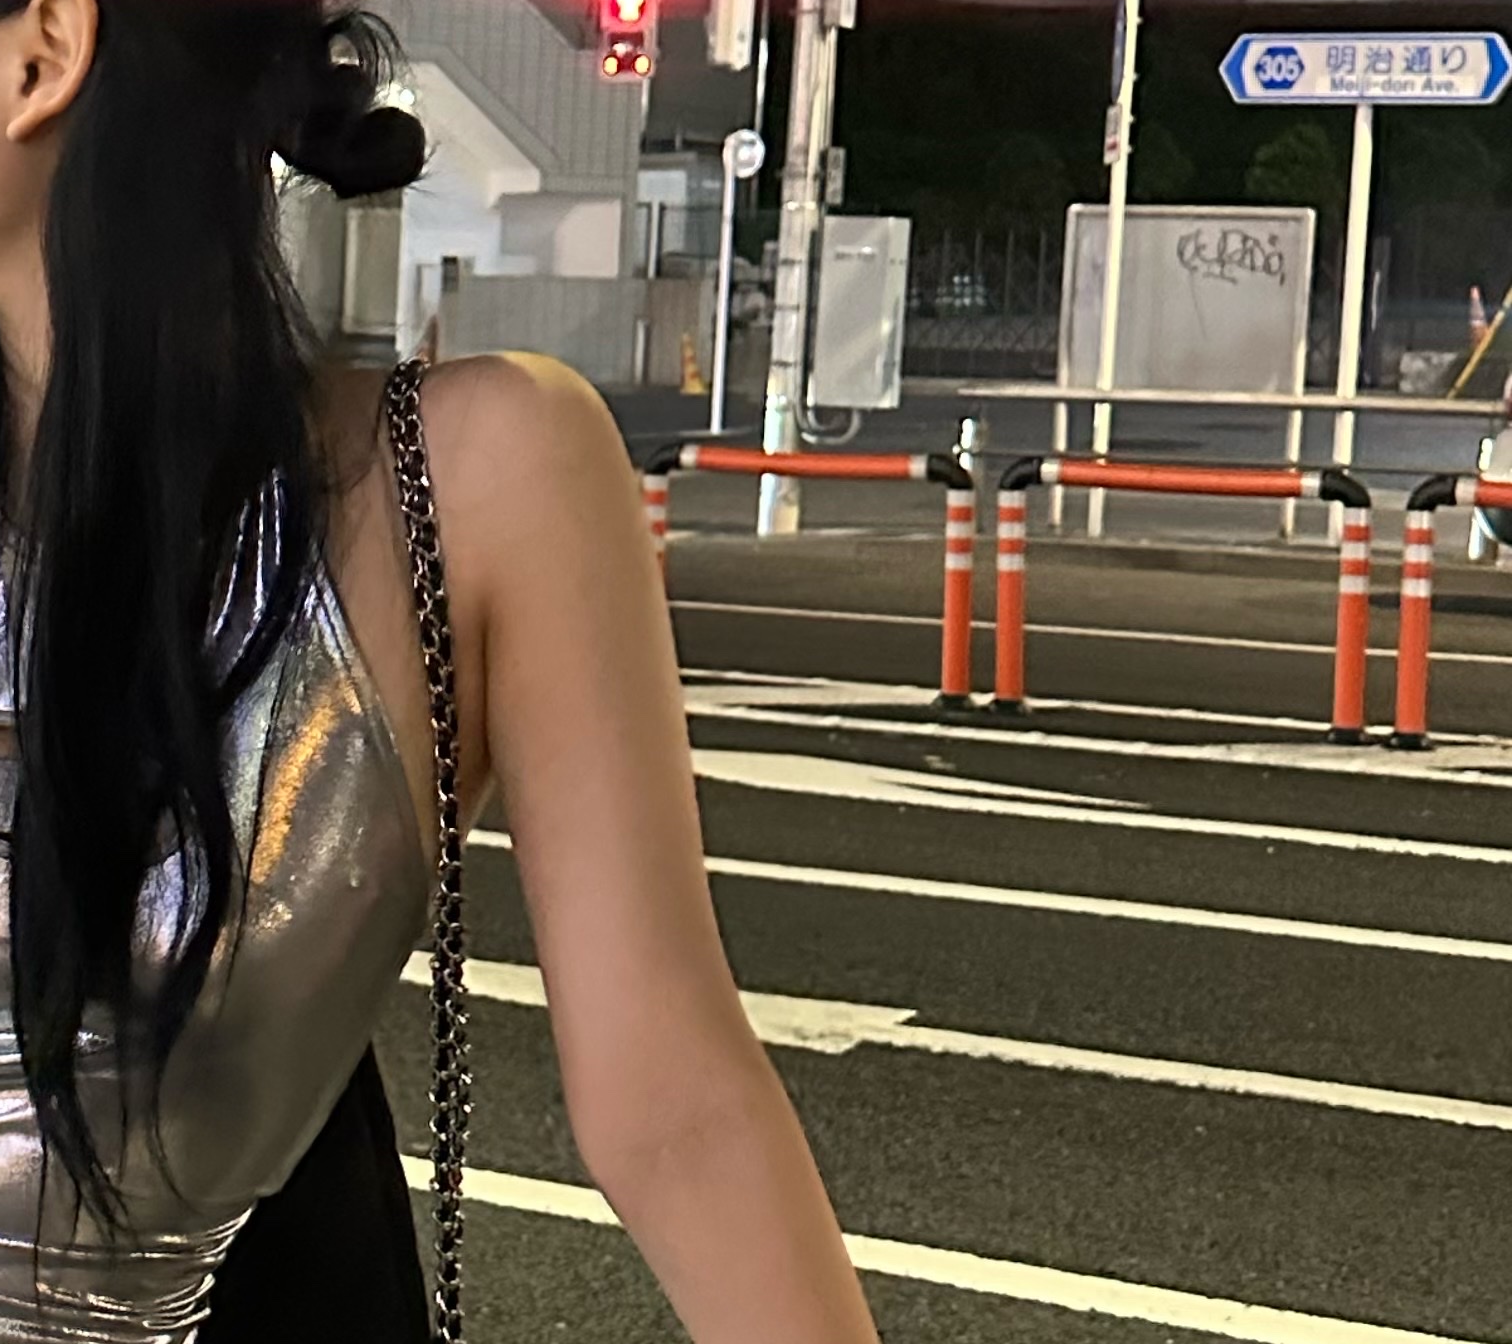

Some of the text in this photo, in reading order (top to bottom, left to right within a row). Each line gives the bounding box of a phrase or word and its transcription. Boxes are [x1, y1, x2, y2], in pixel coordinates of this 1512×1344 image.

[1259, 55, 1300, 83] 305
[1326, 44, 1467, 74] 明治通り
